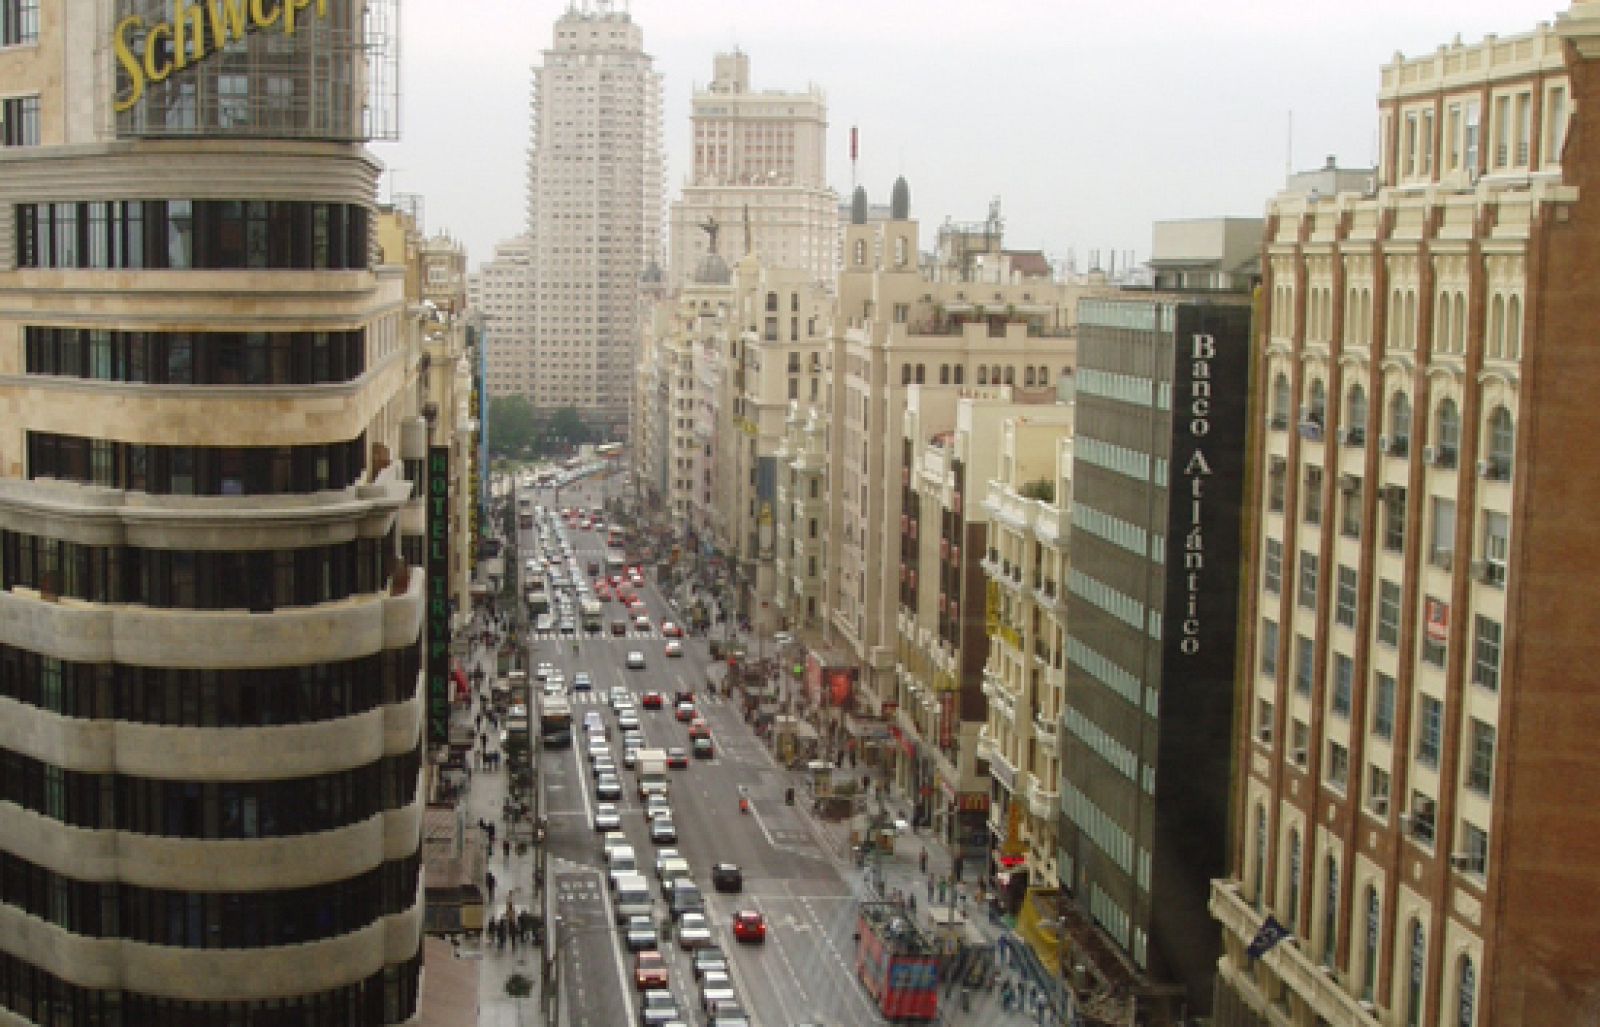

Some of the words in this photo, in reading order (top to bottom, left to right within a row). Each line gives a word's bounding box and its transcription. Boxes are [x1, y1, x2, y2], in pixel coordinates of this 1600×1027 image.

[113, 0, 327, 113] Schwe
[1189, 333, 1217, 437] Banco
[432, 453, 446, 560] HOTEL
[1180, 449, 1213, 656] Atlántico
